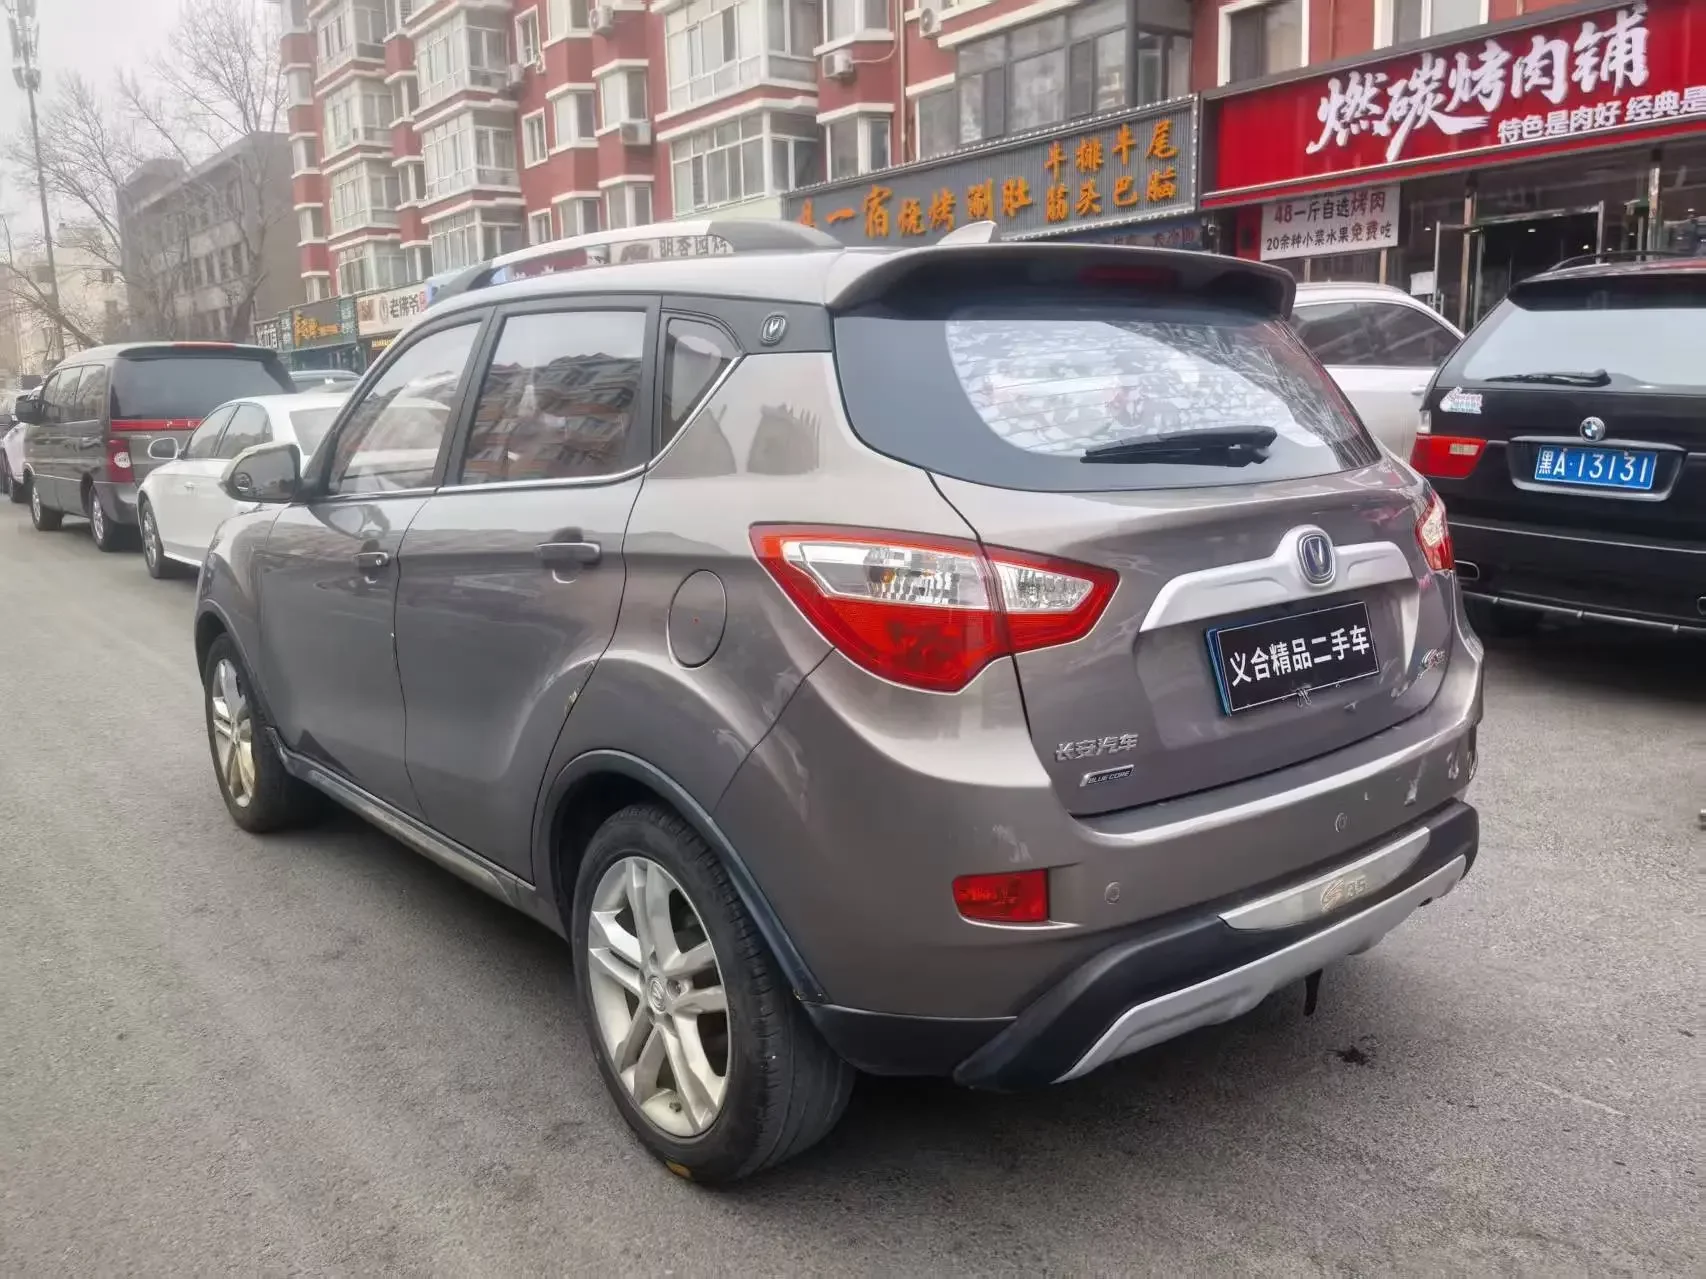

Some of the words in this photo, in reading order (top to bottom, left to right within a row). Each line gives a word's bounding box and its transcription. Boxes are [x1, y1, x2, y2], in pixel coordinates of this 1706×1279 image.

[1305, 3, 1650, 163] 燃碳烤肉铺
[1498, 100, 1622, 144] 特色是肉好
[1275, 190, 1386, 224] 48一斤自选烤肉
[1266, 220, 1392, 251] 20余种小菜水果免费吃
[1229, 625, 1370, 687] 义合精品二手车
[1055, 734, 1139, 761] 长安汽车
[1088, 775, 1108, 784] BLUE
